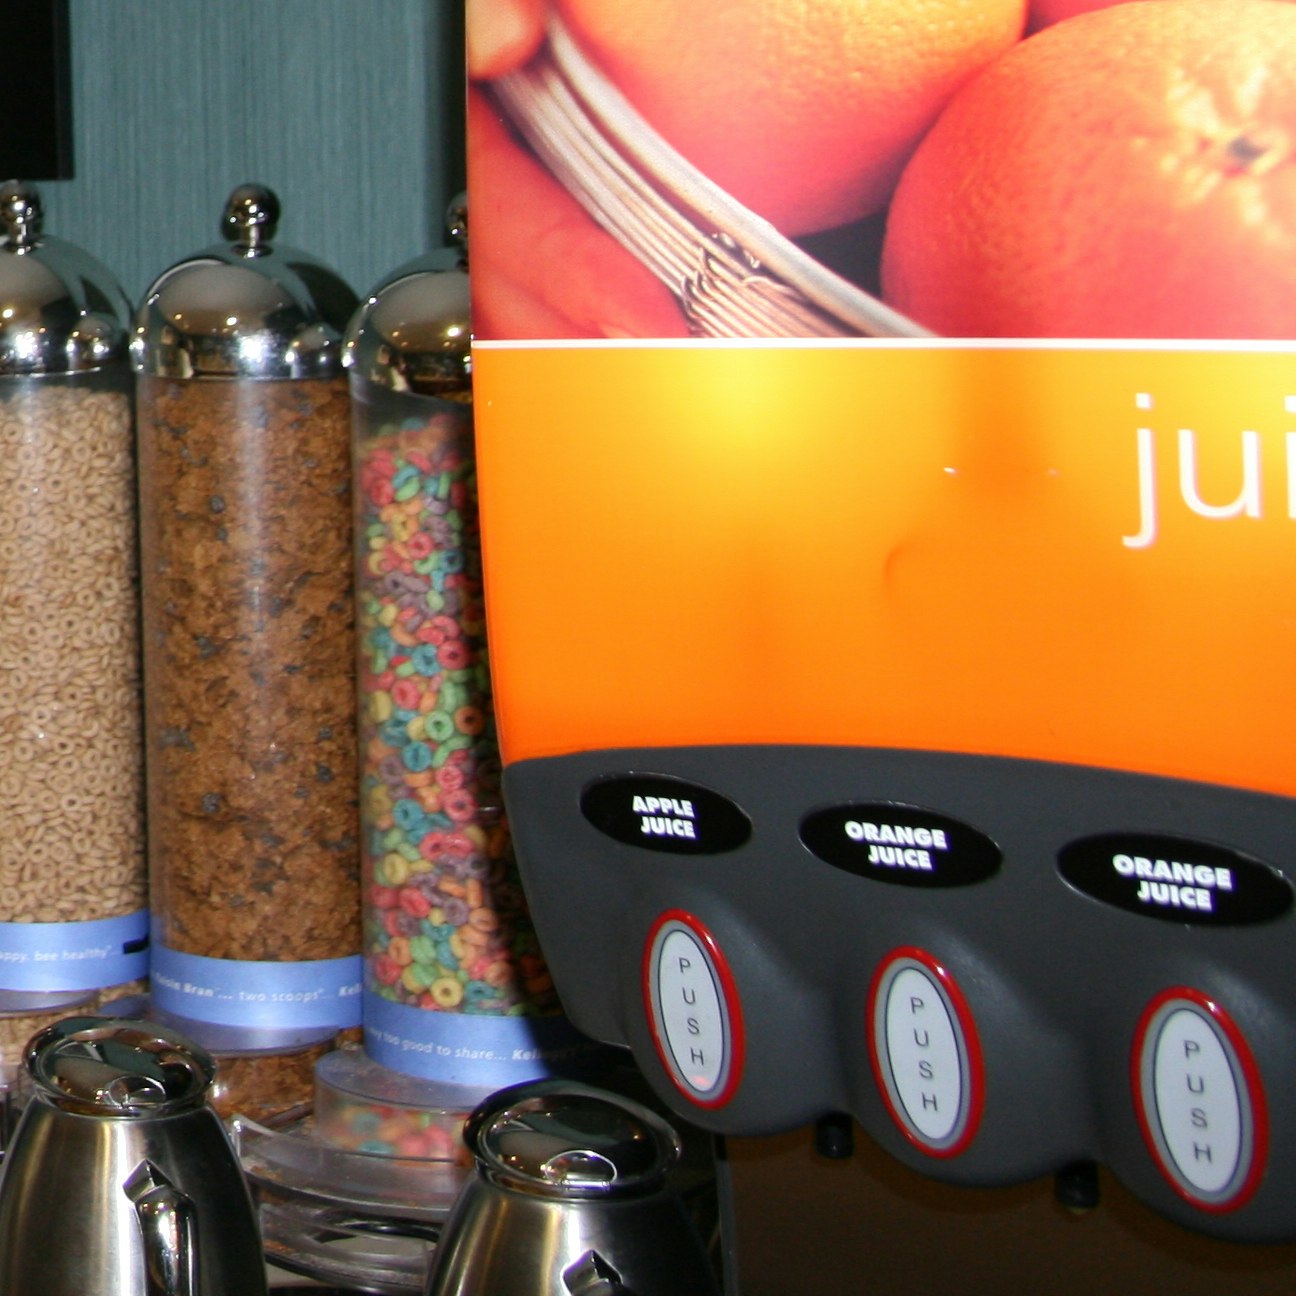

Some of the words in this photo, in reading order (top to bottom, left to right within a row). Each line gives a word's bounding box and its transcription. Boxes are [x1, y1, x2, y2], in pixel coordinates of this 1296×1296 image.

[632, 795, 696, 818] APPLE
[641, 818, 697, 839] JUICE
[845, 820, 948, 850] ORANGE
[867, 845, 934, 870] JUICE
[1112, 854, 1234, 891] ORANGE
[1137, 880, 1213, 912] JUICE
[183, 982, 214, 997] Bran
[238, 991, 267, 1002] two
[678, 957, 706, 1067] PUSH
[402, 1037, 433, 1054] good
[436, 1044, 452, 1057] to
[909, 996, 939, 1112] PUSH
[1183, 1039, 1214, 1165] PUSH
